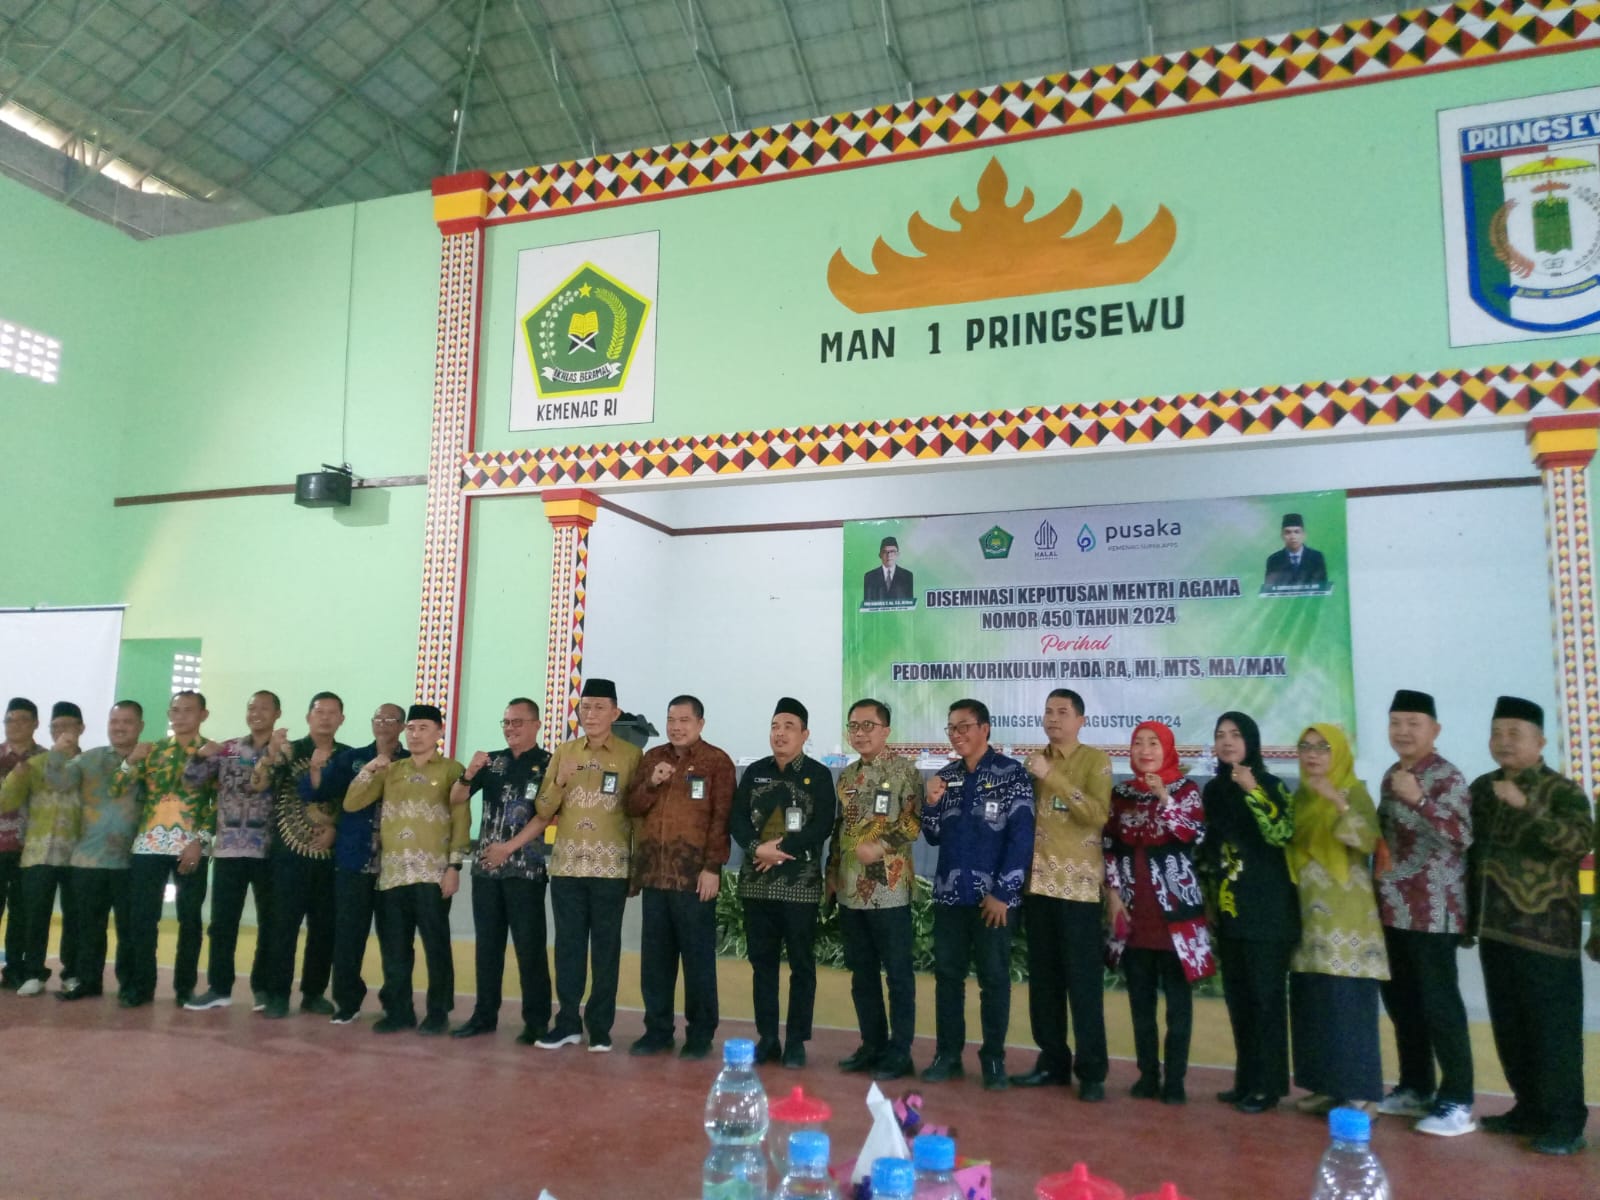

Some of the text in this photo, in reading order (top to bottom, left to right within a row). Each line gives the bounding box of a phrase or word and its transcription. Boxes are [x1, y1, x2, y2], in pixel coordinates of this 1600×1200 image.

[820, 295, 1185, 363] MAN 1 PRINGSEWU
[537, 398, 617, 421] KEMENAG RI
[1106, 518, 1181, 543] pusaka
[926, 579, 1241, 607] DISEMINASI KEPUTUSAN MENTRI AGAMA
[982, 606, 1176, 629] NOMOR 450 TAHUN 2024
[1041, 634, 1113, 655] Perihal
[893, 657, 1287, 681] PEDOMAN KURIKULUM PADA RA, MI, MTS, MA/MAK
[989, 715, 1044, 728] RINGSEW
[1083, 715, 1142, 728] AGUSTUS
